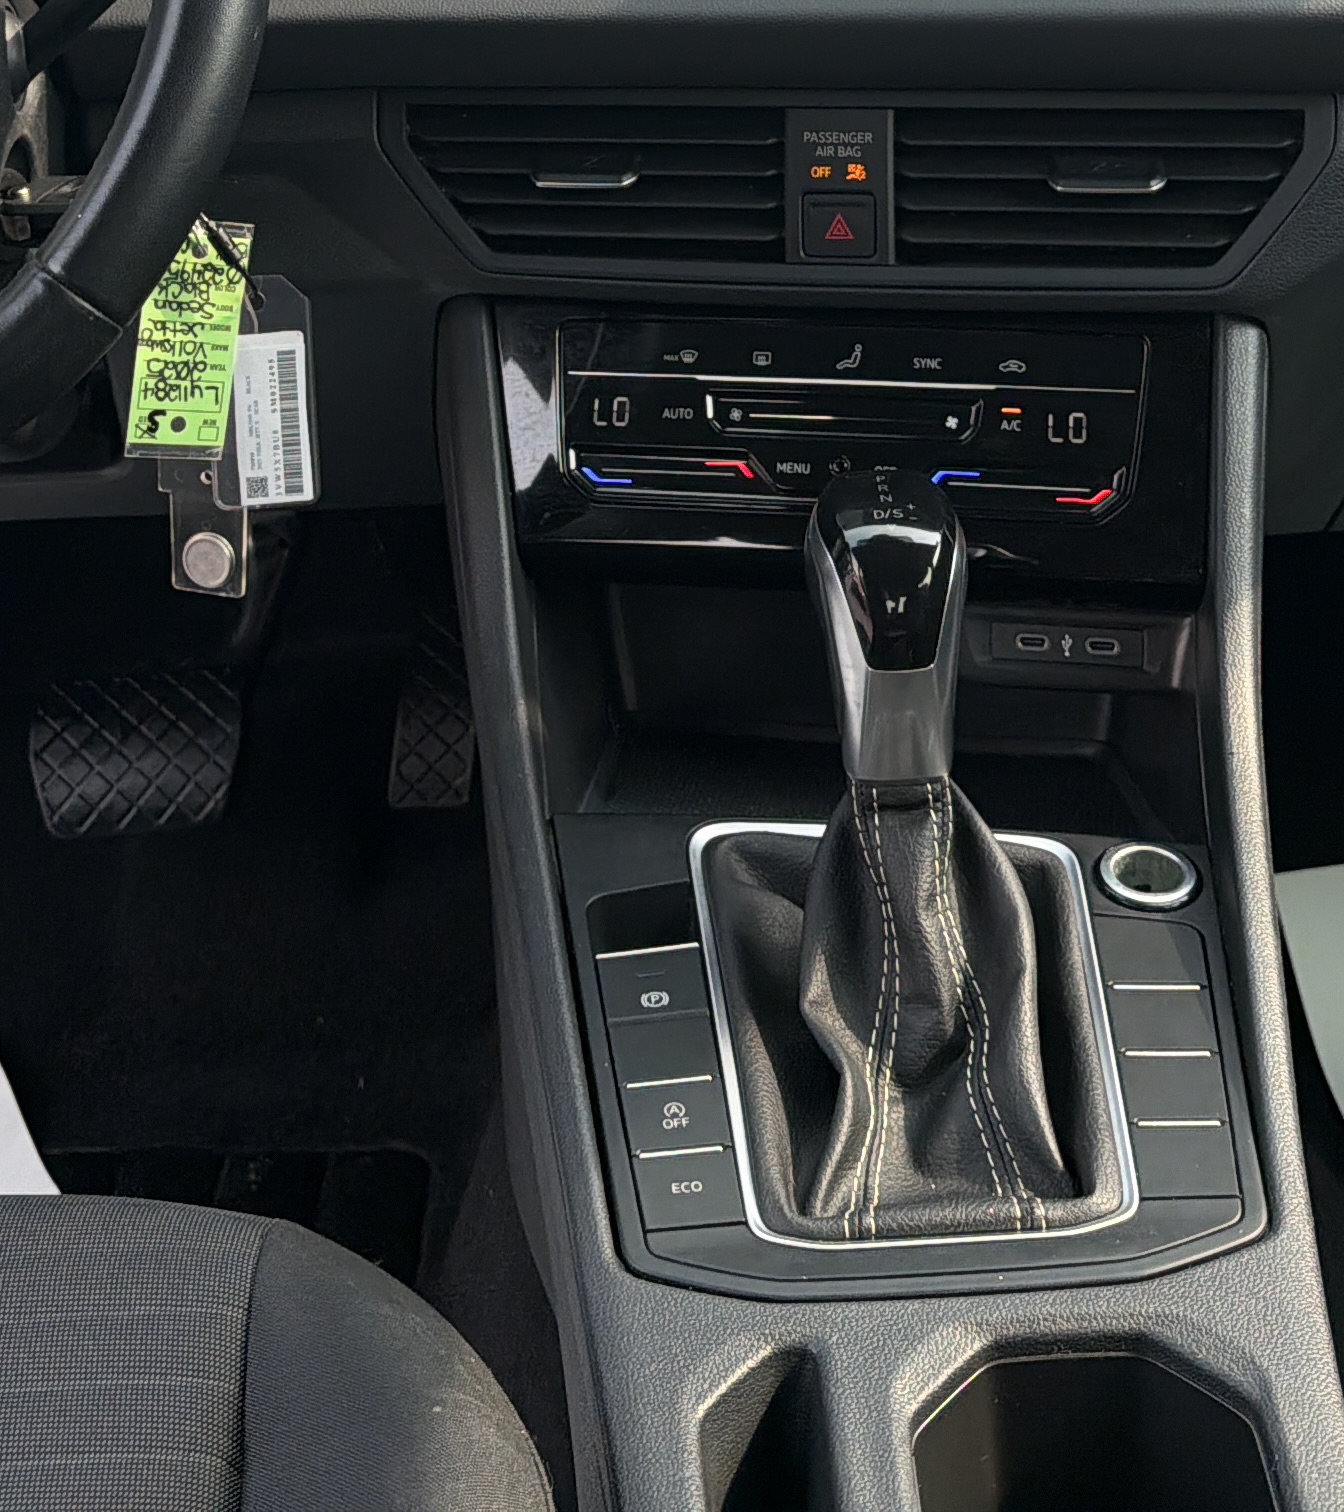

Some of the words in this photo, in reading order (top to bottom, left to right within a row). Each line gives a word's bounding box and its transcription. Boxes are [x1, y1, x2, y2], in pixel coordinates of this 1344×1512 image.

[803, 131, 873, 144] PASSENGER
[815, 145, 835, 158] AIR
[837, 145, 862, 158] BAG
[810, 166, 832, 178] OFF
[152, 298, 216, 319] Sedan
[912, 356, 943, 371] SYNC
[593, 396, 630, 427] LO
[662, 407, 694, 420] AUTO
[1000, 419, 1022, 432] A/C
[1047, 412, 1087, 444] LO
[776, 462, 811, 475] MENU
[876, 475, 886, 483] P
[878, 484, 889, 492] R
[880, 494, 893, 503] N
[873, 508, 904, 520] D/S
[662, 1116, 690, 1130] OFF
[671, 1181, 703, 1194] ECO
